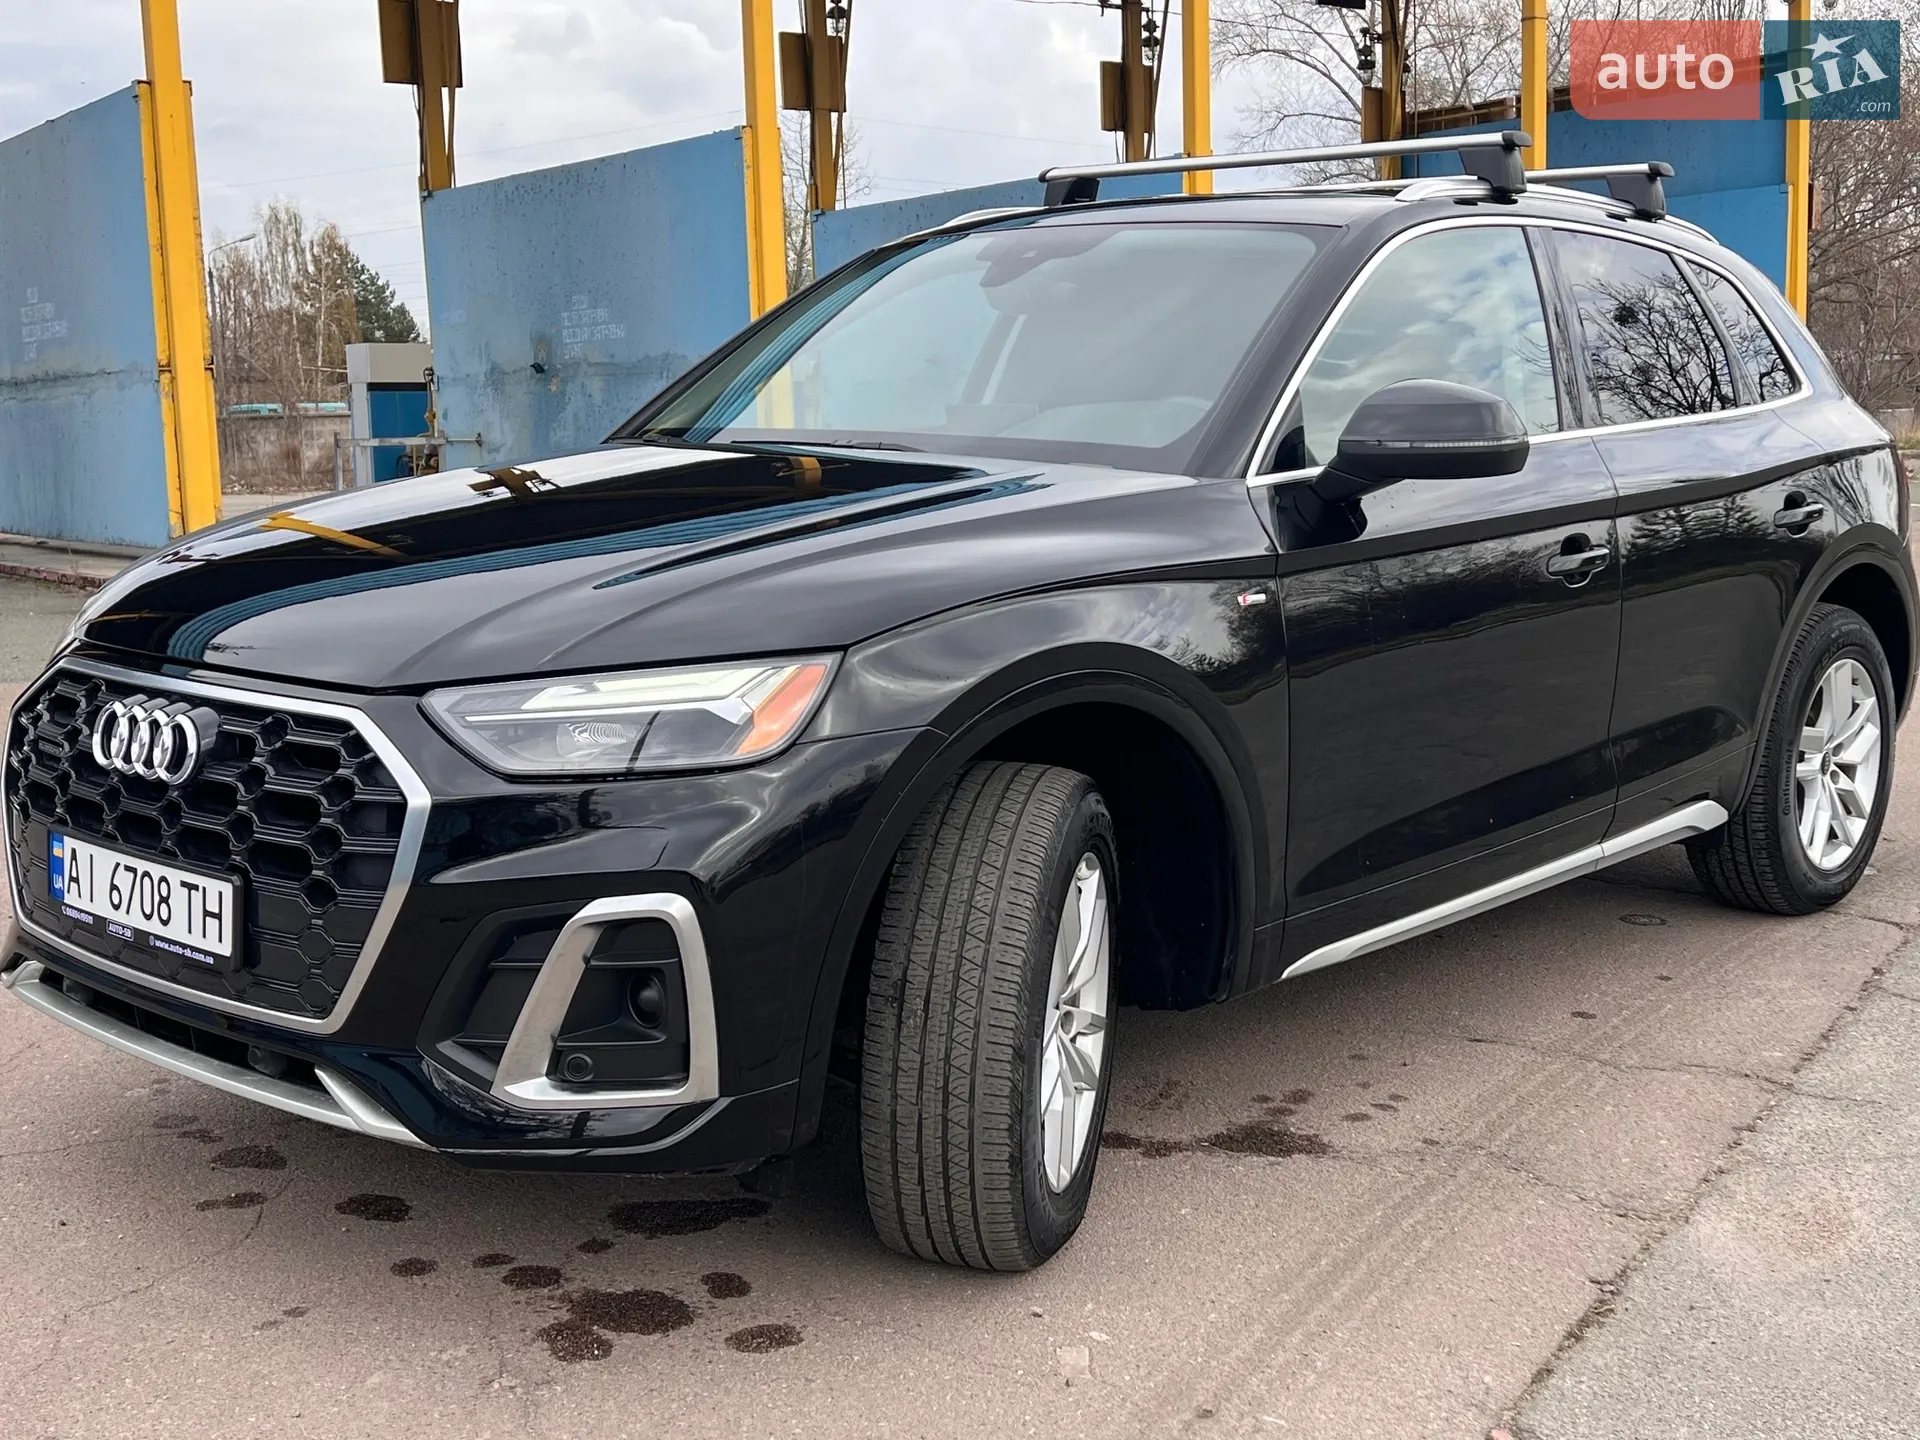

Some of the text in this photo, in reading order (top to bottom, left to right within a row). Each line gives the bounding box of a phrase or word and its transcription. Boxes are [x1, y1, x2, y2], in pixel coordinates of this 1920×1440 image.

[53, 874, 64, 890] UA
[67, 847, 223, 944] AI 6708 TH
[108, 922, 132, 938] AUTO-SB
